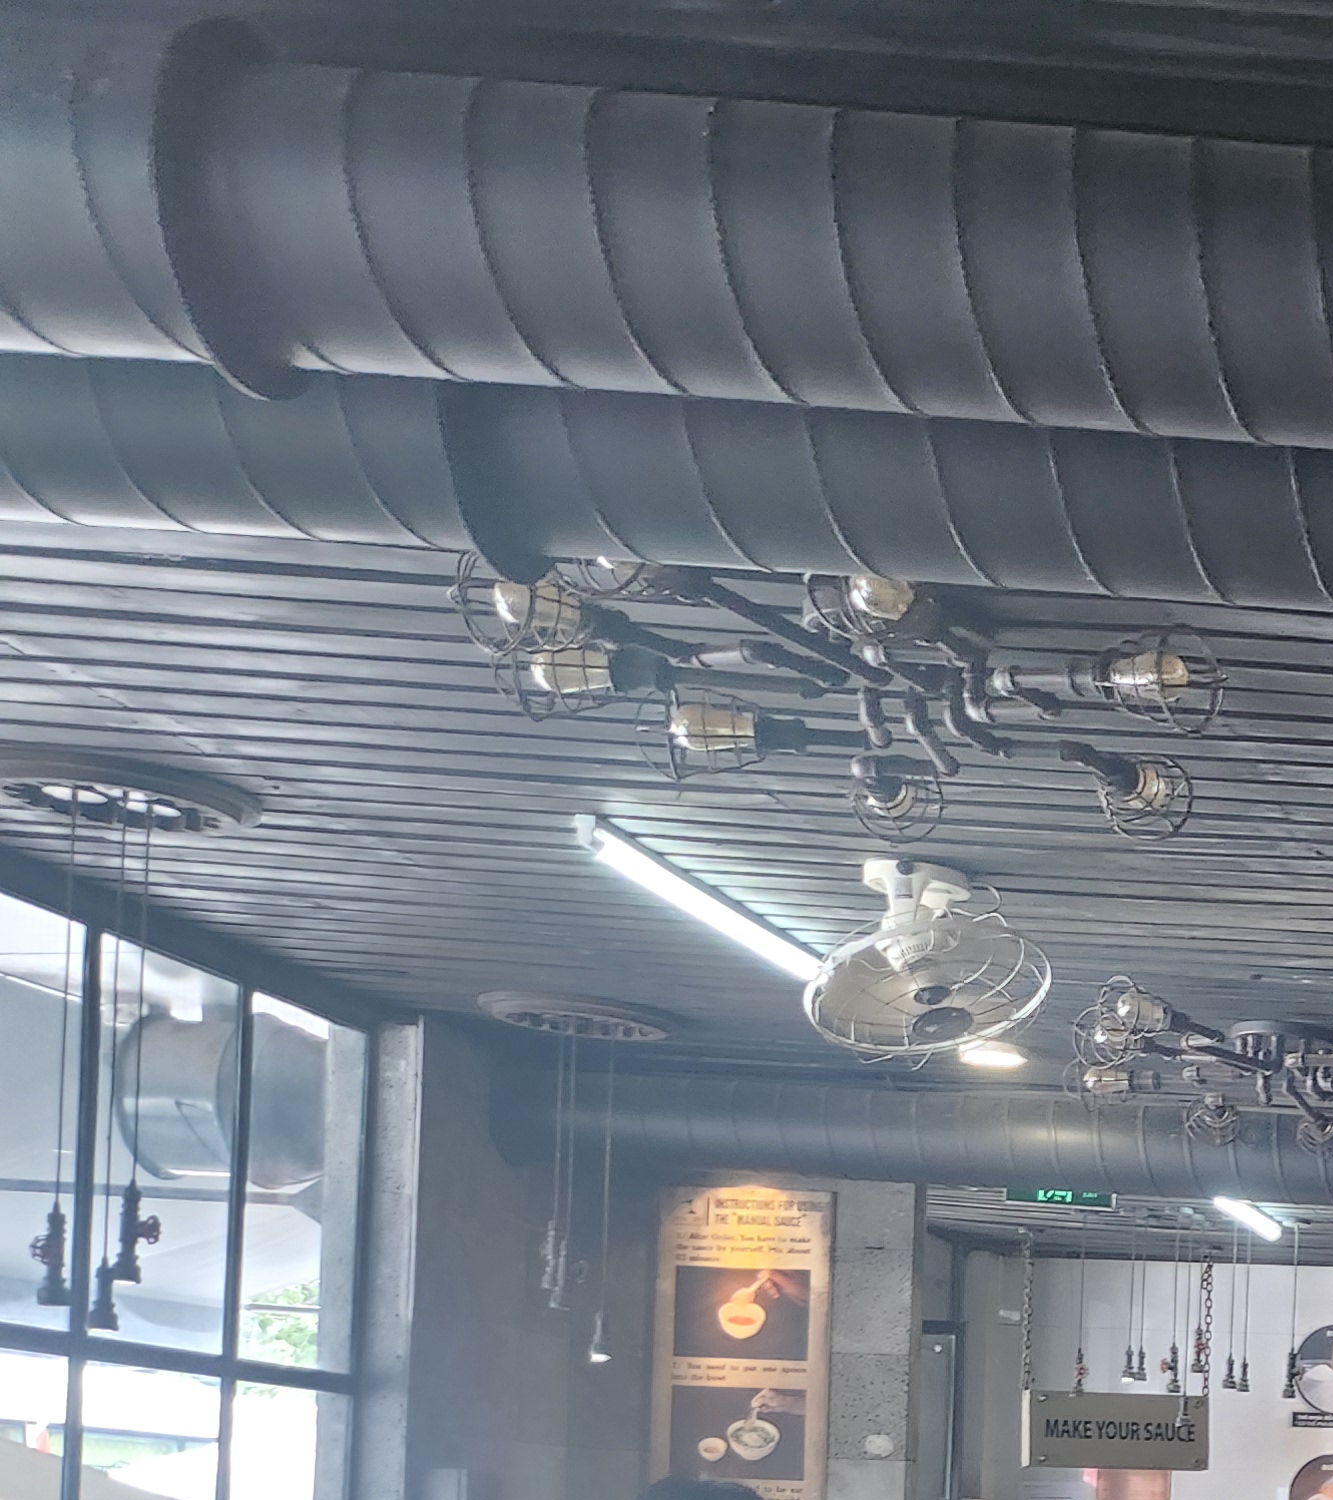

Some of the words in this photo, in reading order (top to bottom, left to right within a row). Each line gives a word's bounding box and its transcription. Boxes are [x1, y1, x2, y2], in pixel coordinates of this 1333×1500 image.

[715, 1199, 775, 1210] INSTRUCTIONS
[779, 1200, 794, 1211] FOR
[797, 1201, 825, 1212] USING
[715, 1213, 729, 1225] THE
[1044, 1418, 1093, 1439] MAKE
[1096, 1420, 1140, 1441] YOUR
[1143, 1422, 1196, 1442] SAUCE
